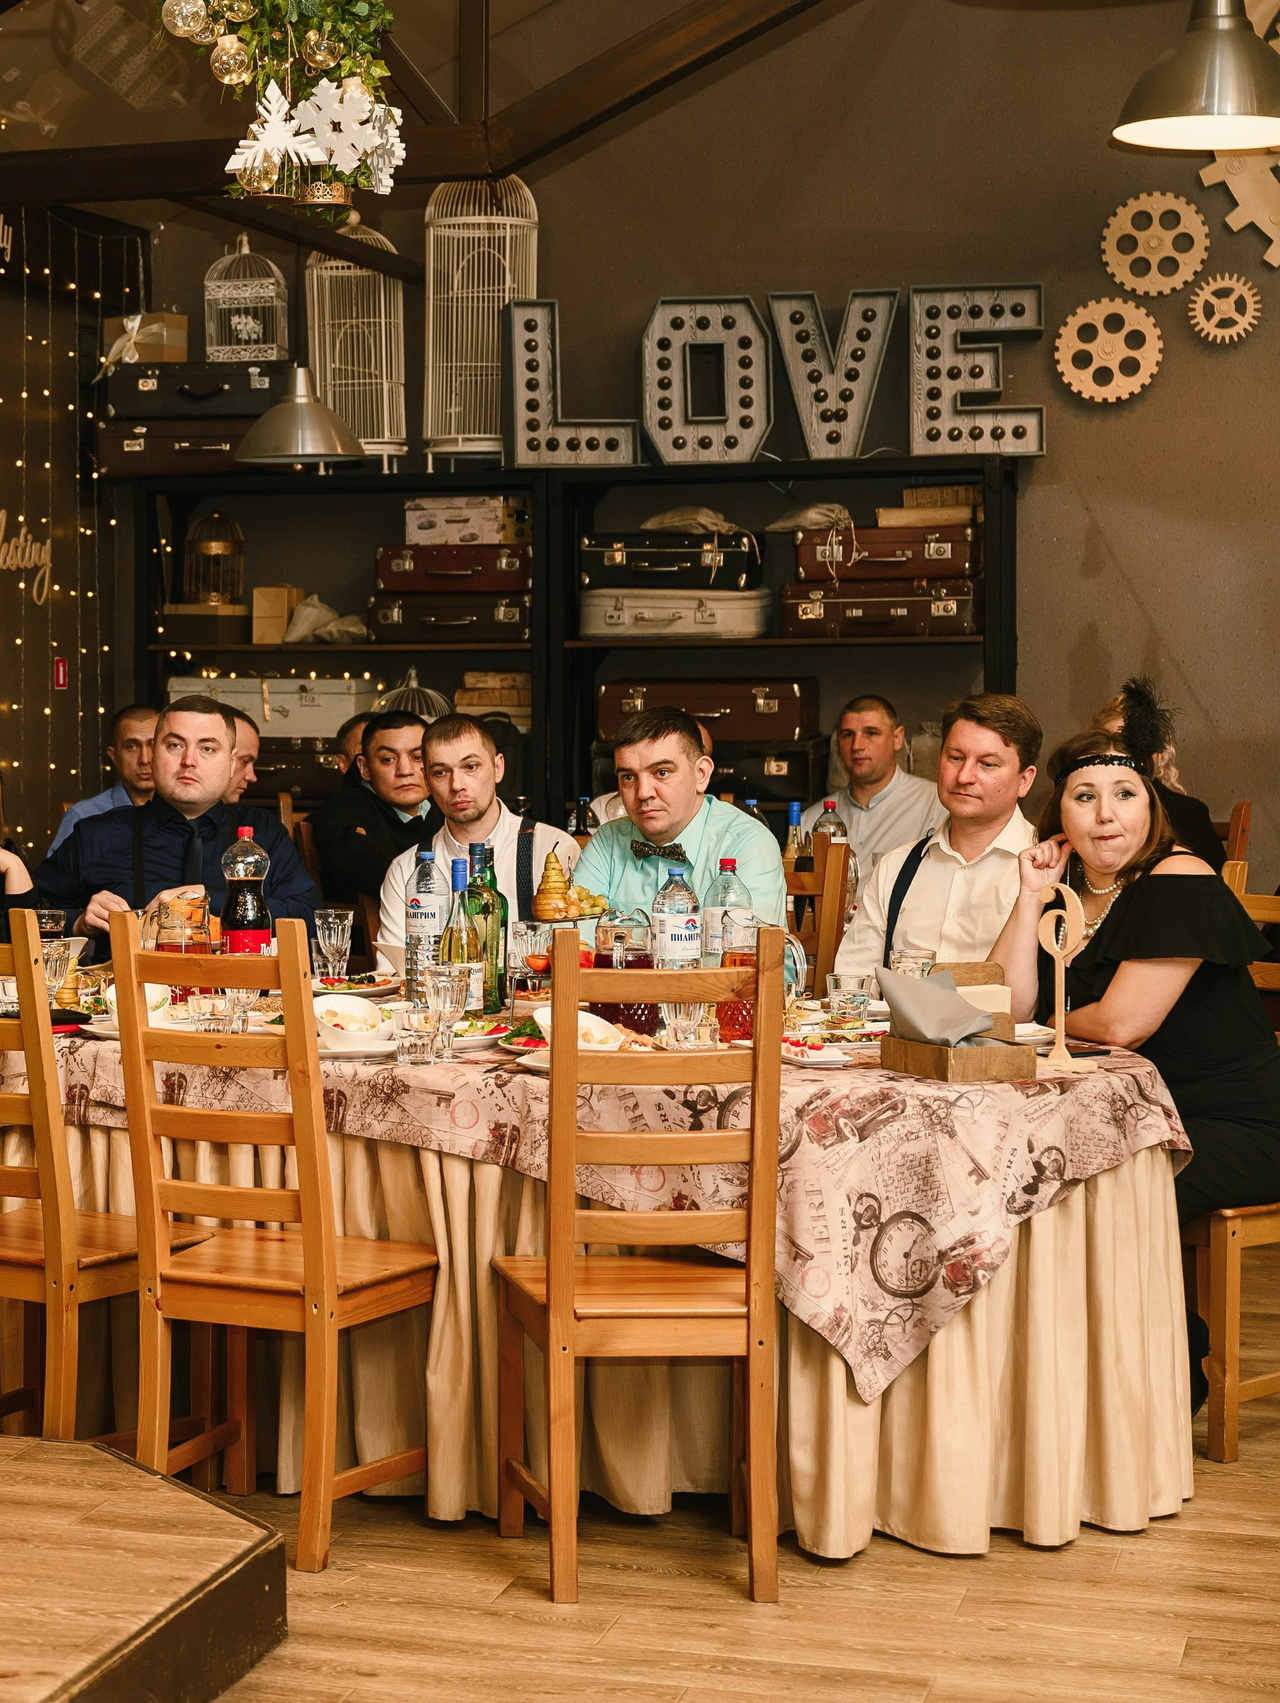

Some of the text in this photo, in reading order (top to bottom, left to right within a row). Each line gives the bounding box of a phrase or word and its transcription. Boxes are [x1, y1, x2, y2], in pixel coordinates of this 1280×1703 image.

[503, 283, 1046, 467] LOVE
[405, 911, 436, 920] ИЛИГРИМ
[670, 932, 700, 942] ПИЛИГР
